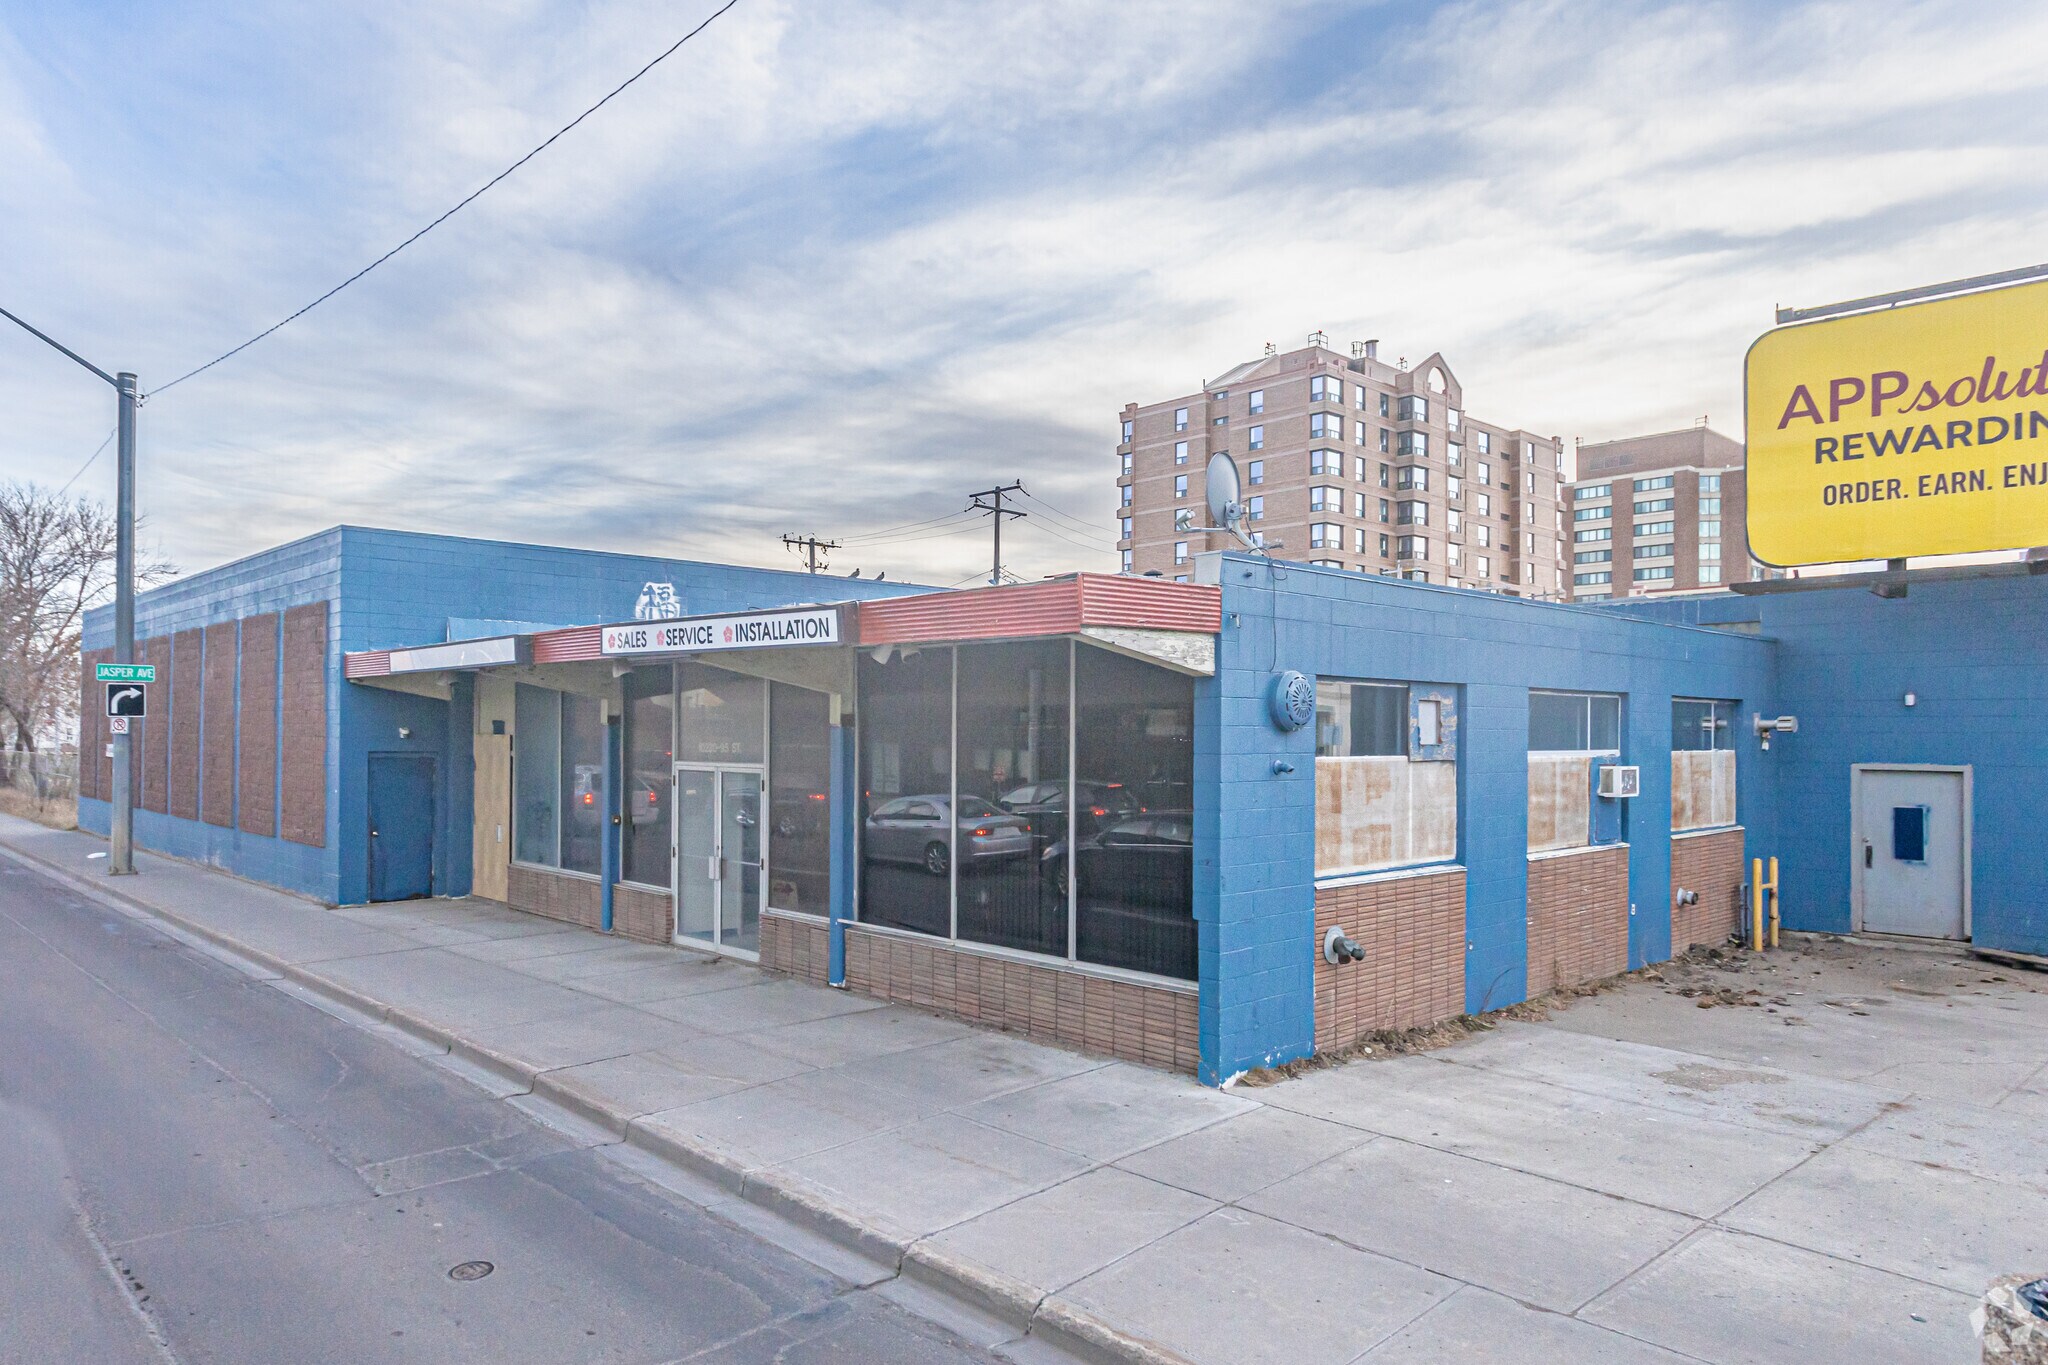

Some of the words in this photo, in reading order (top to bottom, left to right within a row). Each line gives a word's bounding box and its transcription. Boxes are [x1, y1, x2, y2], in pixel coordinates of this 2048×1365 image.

[1823, 478, 1909, 506] ORDER.
[1918, 469, 1993, 497] EARN.
[2003, 462, 2048, 488] ENJ
[617, 630, 647, 649] SALES
[665, 625, 713, 646] SERVICE
[735, 617, 830, 642] INSTALLATION
[97, 667, 134, 678] JASPER
[137, 668, 154, 678] AVE
